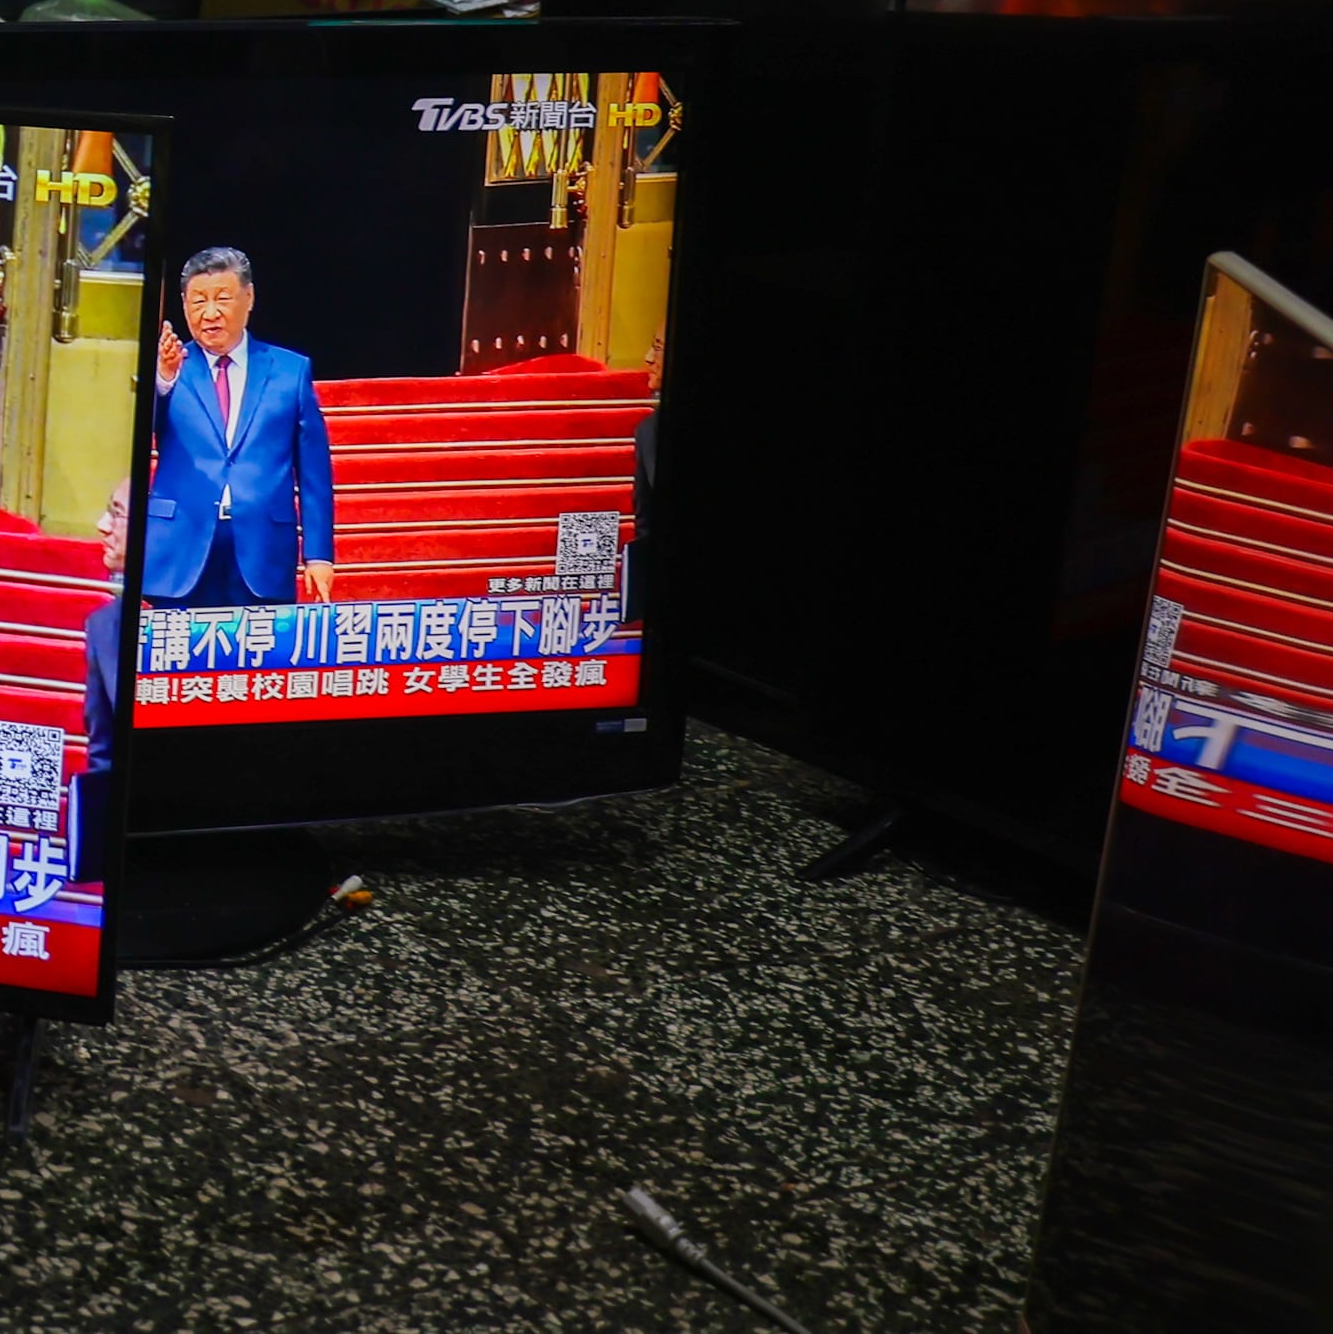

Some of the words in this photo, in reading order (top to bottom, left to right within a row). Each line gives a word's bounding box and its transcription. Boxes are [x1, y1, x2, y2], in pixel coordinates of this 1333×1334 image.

[608, 102, 662, 128] HD
[35, 169, 117, 207] HD
[487, 574, 615, 594] 更多新聞在這裡
[290, 592, 621, 666] 川習兩度停下腳步
[403, 658, 608, 695] 女學生全發瘋
